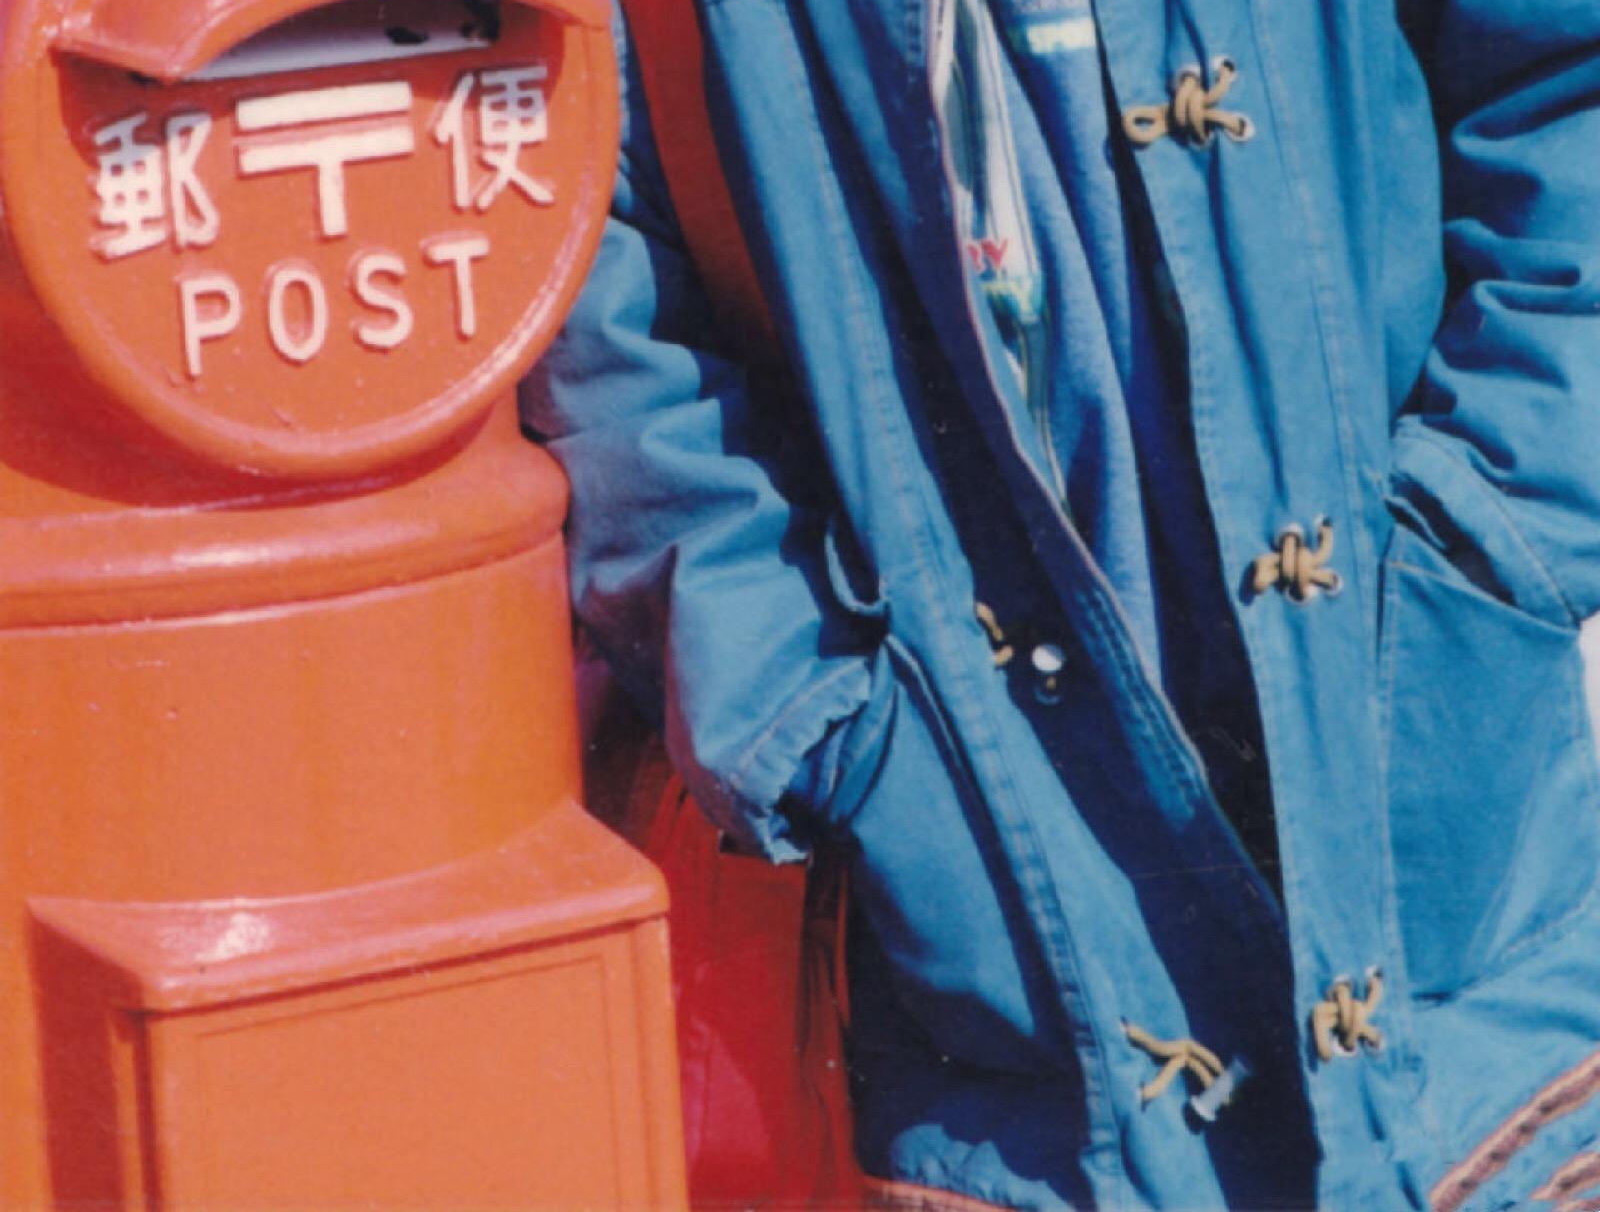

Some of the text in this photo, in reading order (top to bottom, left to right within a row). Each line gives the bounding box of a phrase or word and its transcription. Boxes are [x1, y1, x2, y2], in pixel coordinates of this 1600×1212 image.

[94, 66, 555, 259] 郵 便
[180, 235, 490, 378] POST
